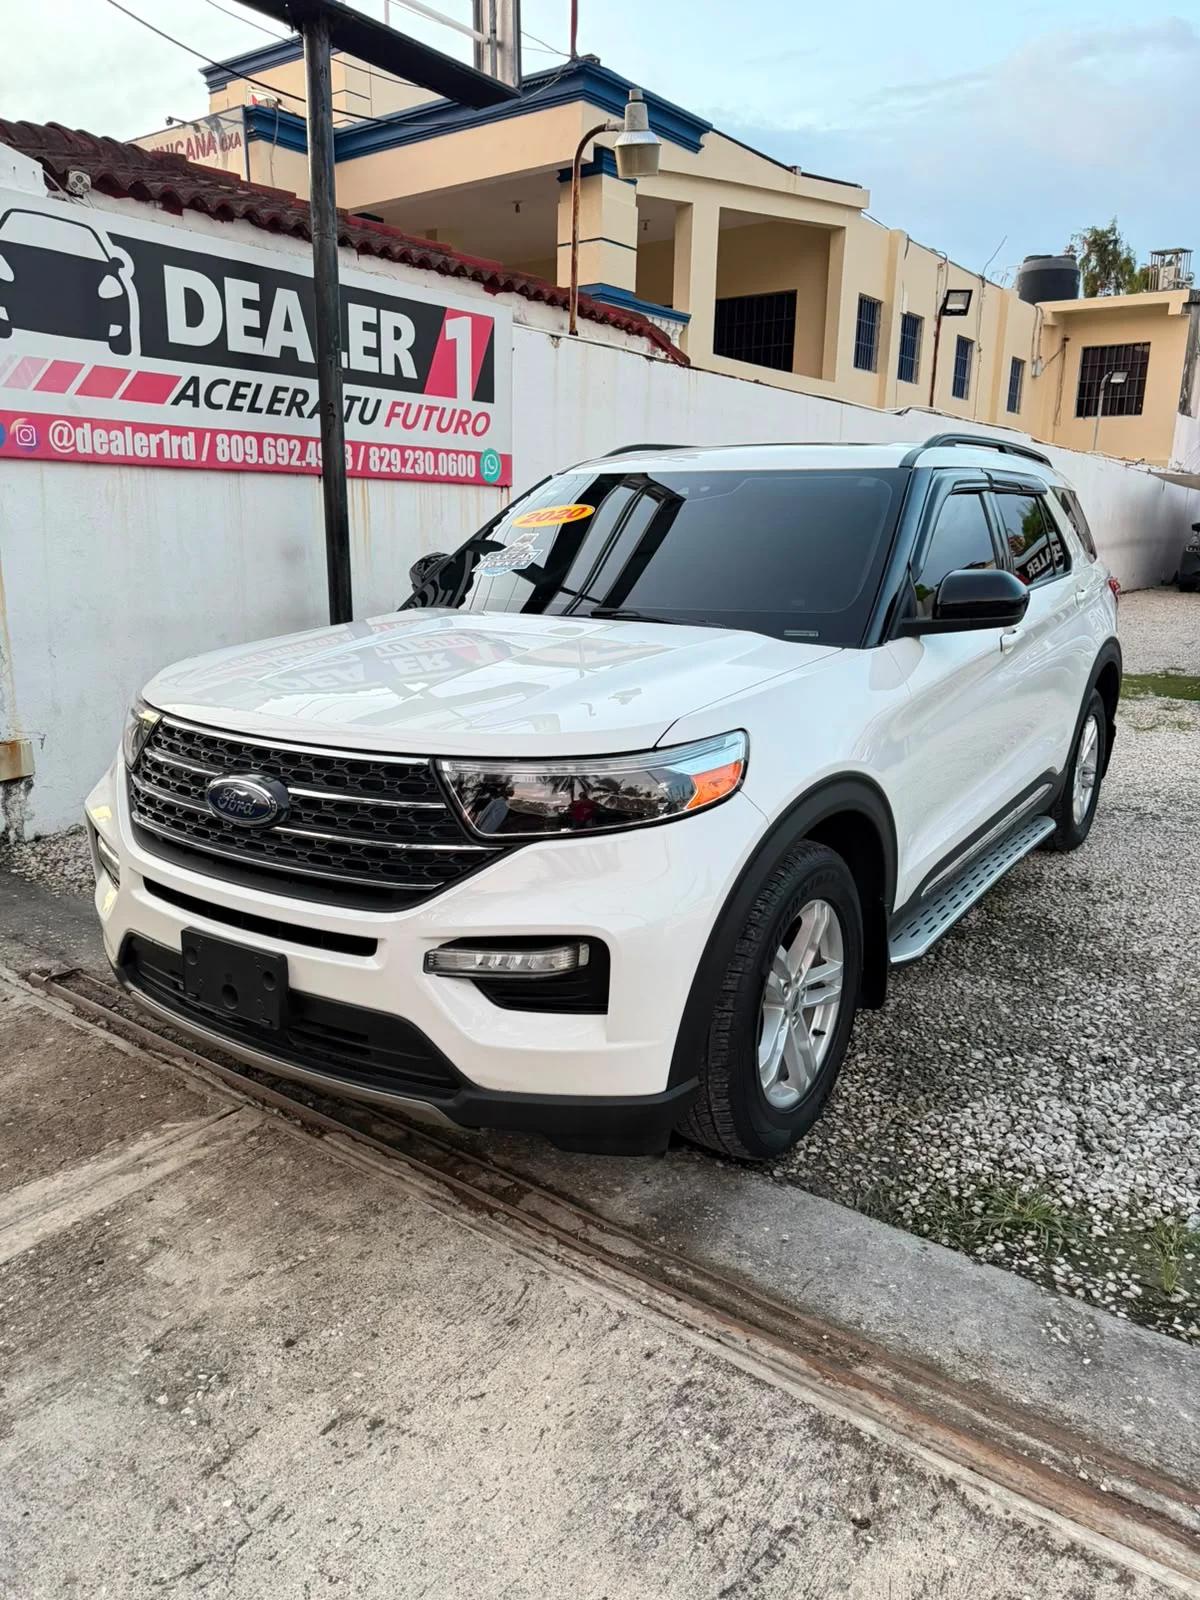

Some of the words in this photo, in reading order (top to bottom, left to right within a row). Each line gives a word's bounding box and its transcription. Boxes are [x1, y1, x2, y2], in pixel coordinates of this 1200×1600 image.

[163, 264, 418, 380] DEAER
[445, 316, 473, 402] 1
[344, 395, 382, 426] TU
[384, 401, 491, 437] FUTURO
[49, 420, 196, 461] @dealer1rd
[216, 433, 353, 470] 809.692.43
[369, 447, 476, 478] 829.230.0600
[519, 507, 588, 524] 2020
[217, 787, 257, 815] Ford
